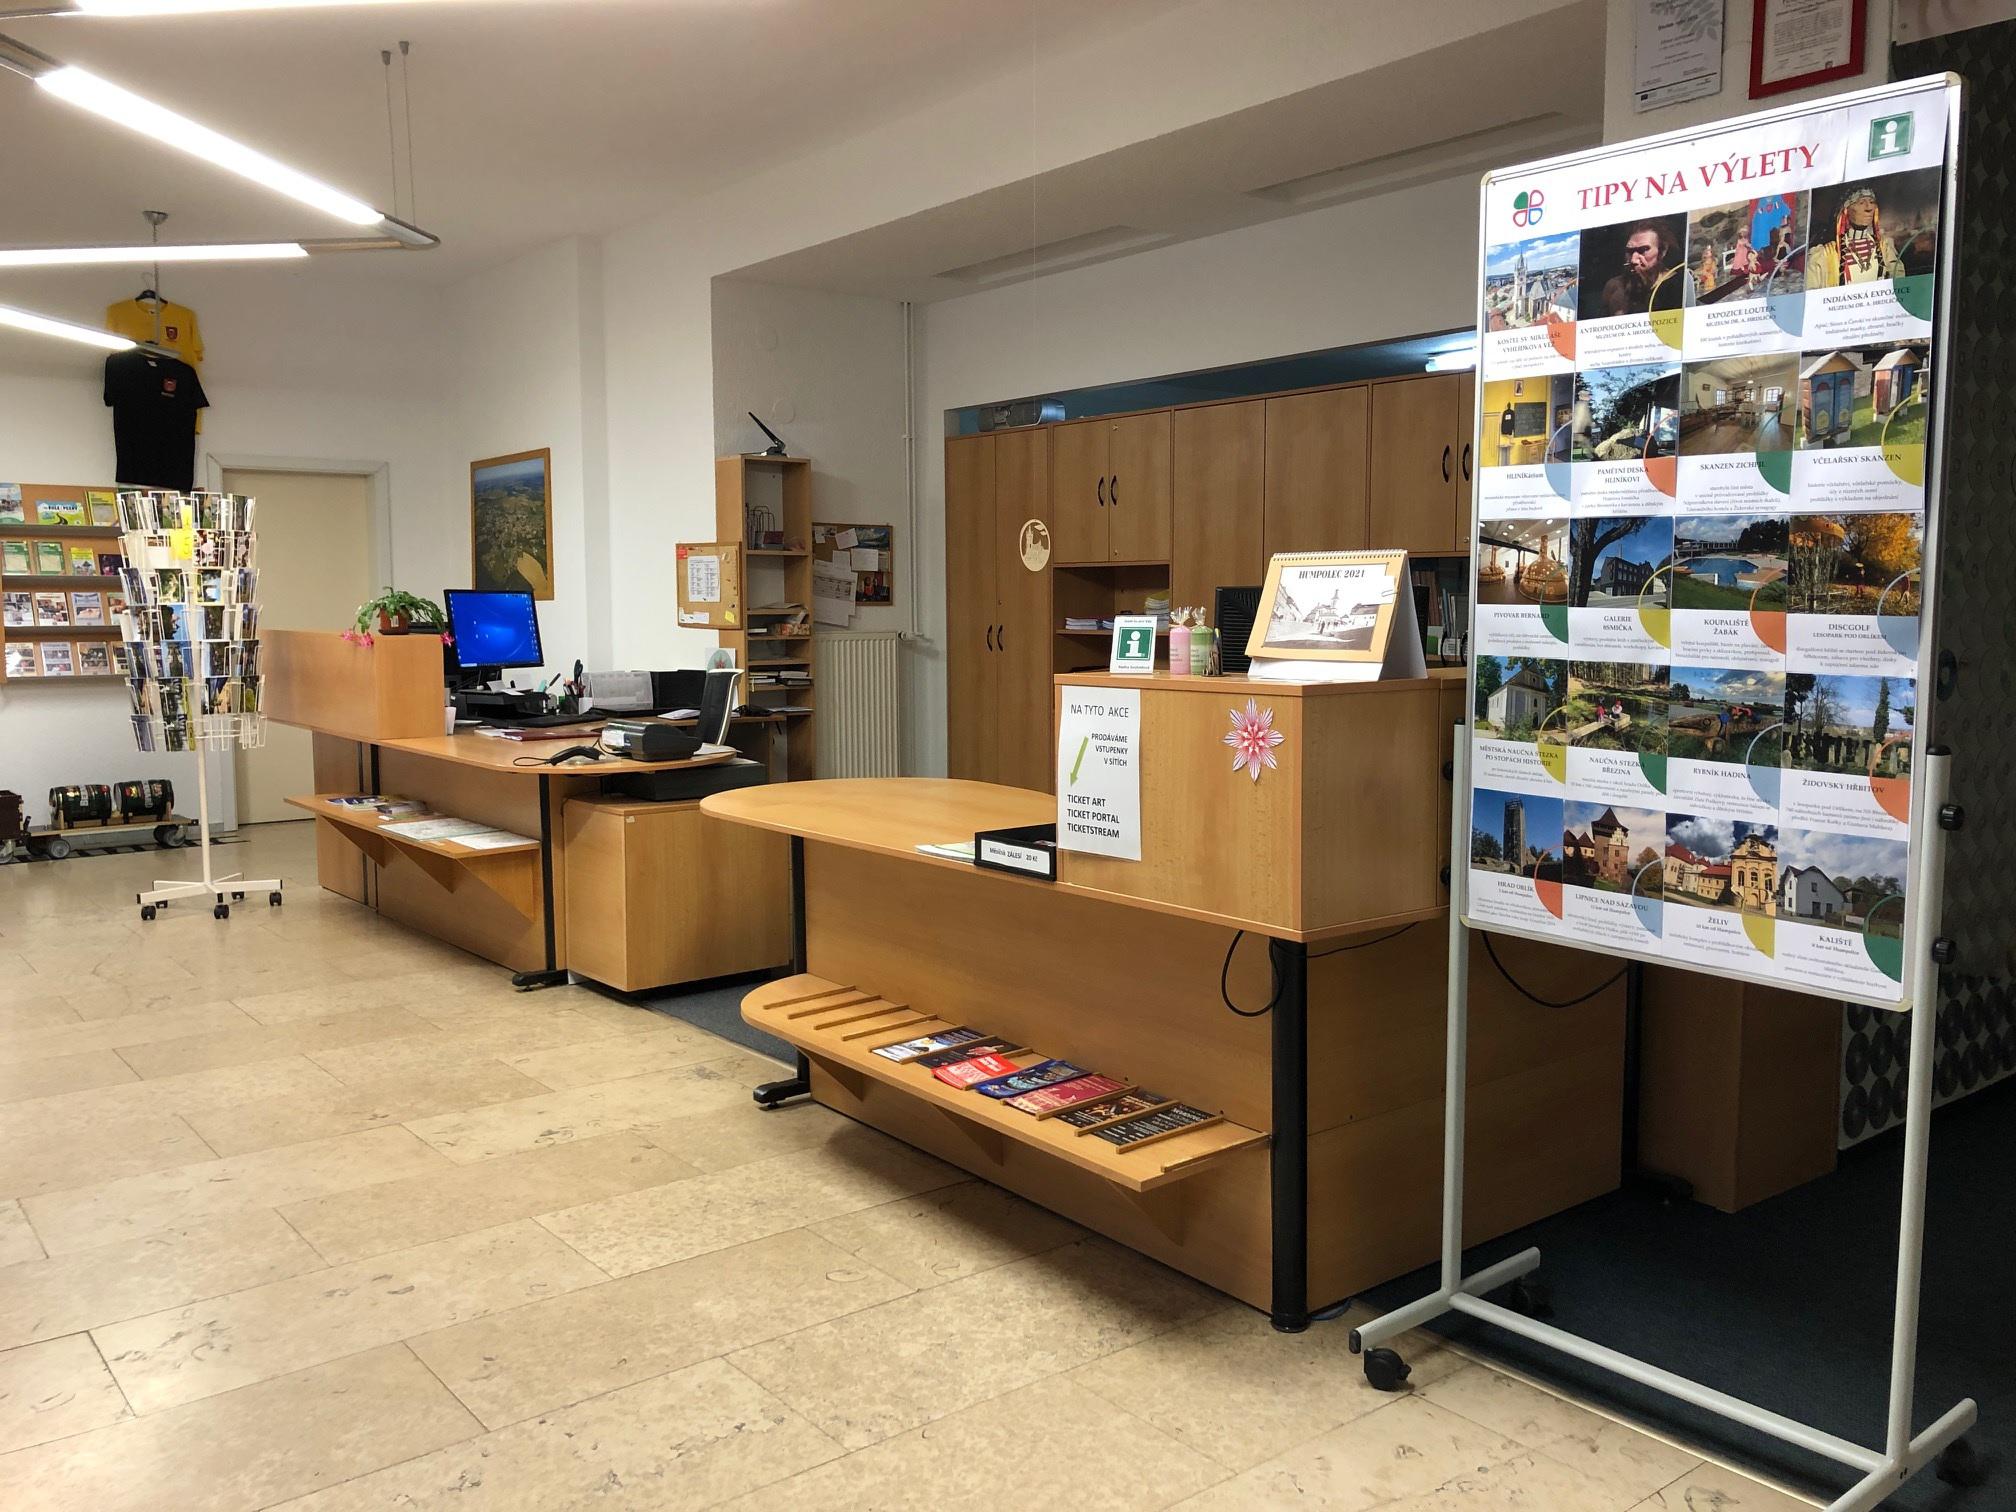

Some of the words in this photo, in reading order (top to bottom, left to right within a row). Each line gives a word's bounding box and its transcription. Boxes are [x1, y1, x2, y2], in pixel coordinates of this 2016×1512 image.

[1577, 178, 1638, 210] TIPY
[1645, 170, 1688, 199] NA
[1699, 143, 1819, 187] VÝLETY
[1823, 291, 1869, 304] INDIÁNSKÁ
[1870, 286, 1911, 298] EXPOZICE
[1707, 309, 1743, 320] EXPOZICE
[1744, 305, 1776, 315] LOUTEK
[1580, 321, 1642, 335] ANTROPOLOGICKÁ
[1643, 317, 1678, 327] EXPOZICE
[1813, 455, 1859, 465] VČELAŘSKÝ
[1859, 453, 1902, 463] SKANZEN
[1598, 467, 1626, 475] PAMĚTNÍ
[1626, 466, 1649, 474] DESKA
[1700, 461, 1735, 470] SKANZEN
[1736, 460, 1765, 469] ZICHPIL
[1605, 475, 1640, 483] HLINÍKOVI
[1299, 569, 1342, 579] HUMPOLEC
[1344, 569, 1365, 578] 2021
[1604, 615, 1632, 623] GALERIE
[1704, 618, 1749, 627] KOUPALIŠTĚ
[1828, 623, 1871, 632] DISCGOLF
[1070, 704, 1082, 715] NA
[1084, 705, 1105, 717] TYTO
[1108, 706, 1129, 718] AKCE
[1091, 732, 1128, 744] PRODÁVÁME
[1095, 745, 1128, 755] VSTUPENKY
[1480, 745, 1506, 753] MĚSTSKÁ
[1507, 748, 1534, 756] NAUČNÁ
[1535, 751, 1559, 759] STEZKA
[1104, 757, 1108, 765] V
[1109, 757, 1128, 767] SÍTÍCH
[1522, 759, 1551, 767] HISTORIE
[1590, 757, 1618, 765] NAUČNÁ
[1619, 760, 1645, 768] STEZKA
[1602, 766, 1631, 775] BŘEZINA
[1693, 767, 1720, 776] RYBNÍK
[1721, 770, 1751, 780] HADINA
[1802, 779, 1844, 789] ŽIDOVSKÝ
[1846, 783, 1885, 793] HŘBITOV
[1067, 794, 1090, 806] TICKET
[1091, 797, 1106, 808] ART
[1067, 808, 1090, 820] TICKET
[1091, 811, 1120, 824] PORTAL
[1067, 822, 1120, 838] TICKETSTREAM
[1007, 850, 1022, 859] ZÁLESÍ
[1575, 893, 1599, 903] LIPNICE
[1708, 916, 1729, 926] ŽELIV
[1819, 935, 1852, 946] KALIŠTĚ
